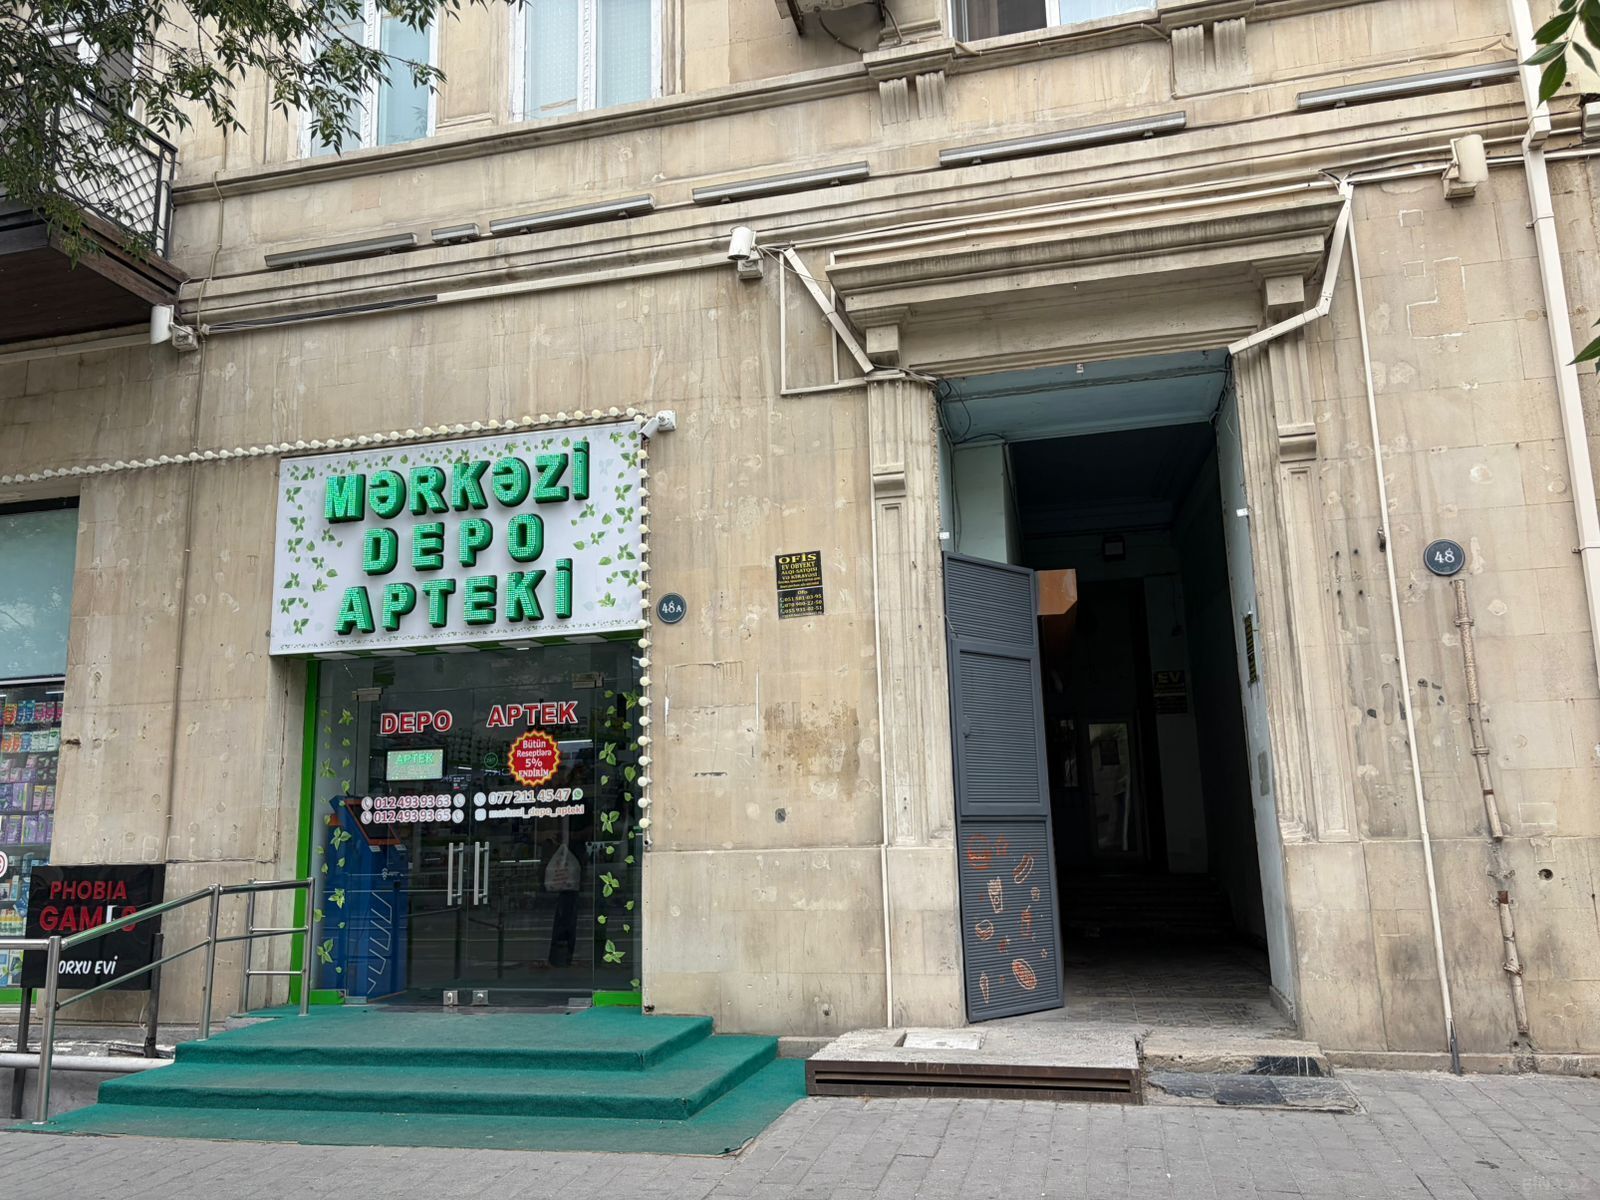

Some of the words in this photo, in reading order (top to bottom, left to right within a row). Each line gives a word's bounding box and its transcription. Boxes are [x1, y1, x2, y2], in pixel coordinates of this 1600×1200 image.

[324, 441, 590, 524] MƏRKƏZİ
[362, 513, 544, 576] DEPO
[778, 553, 817, 564] OFİS
[1434, 548, 1455, 564] 48
[334, 558, 573, 635] APTEKİ
[662, 600, 682, 613] 48A
[380, 709, 453, 735] DEPO
[486, 701, 579, 728] APTEK
[523, 739, 546, 749] Bütün
[525, 758, 543, 768] 5%
[374, 796, 397, 810] 012
[397, 795, 419, 809] 493
[488, 791, 513, 805] 077
[513, 790, 536, 804] 211
[373, 810, 396, 824] 012
[396, 809, 419, 823] 493
[49, 880, 127, 901] PHOBIA
